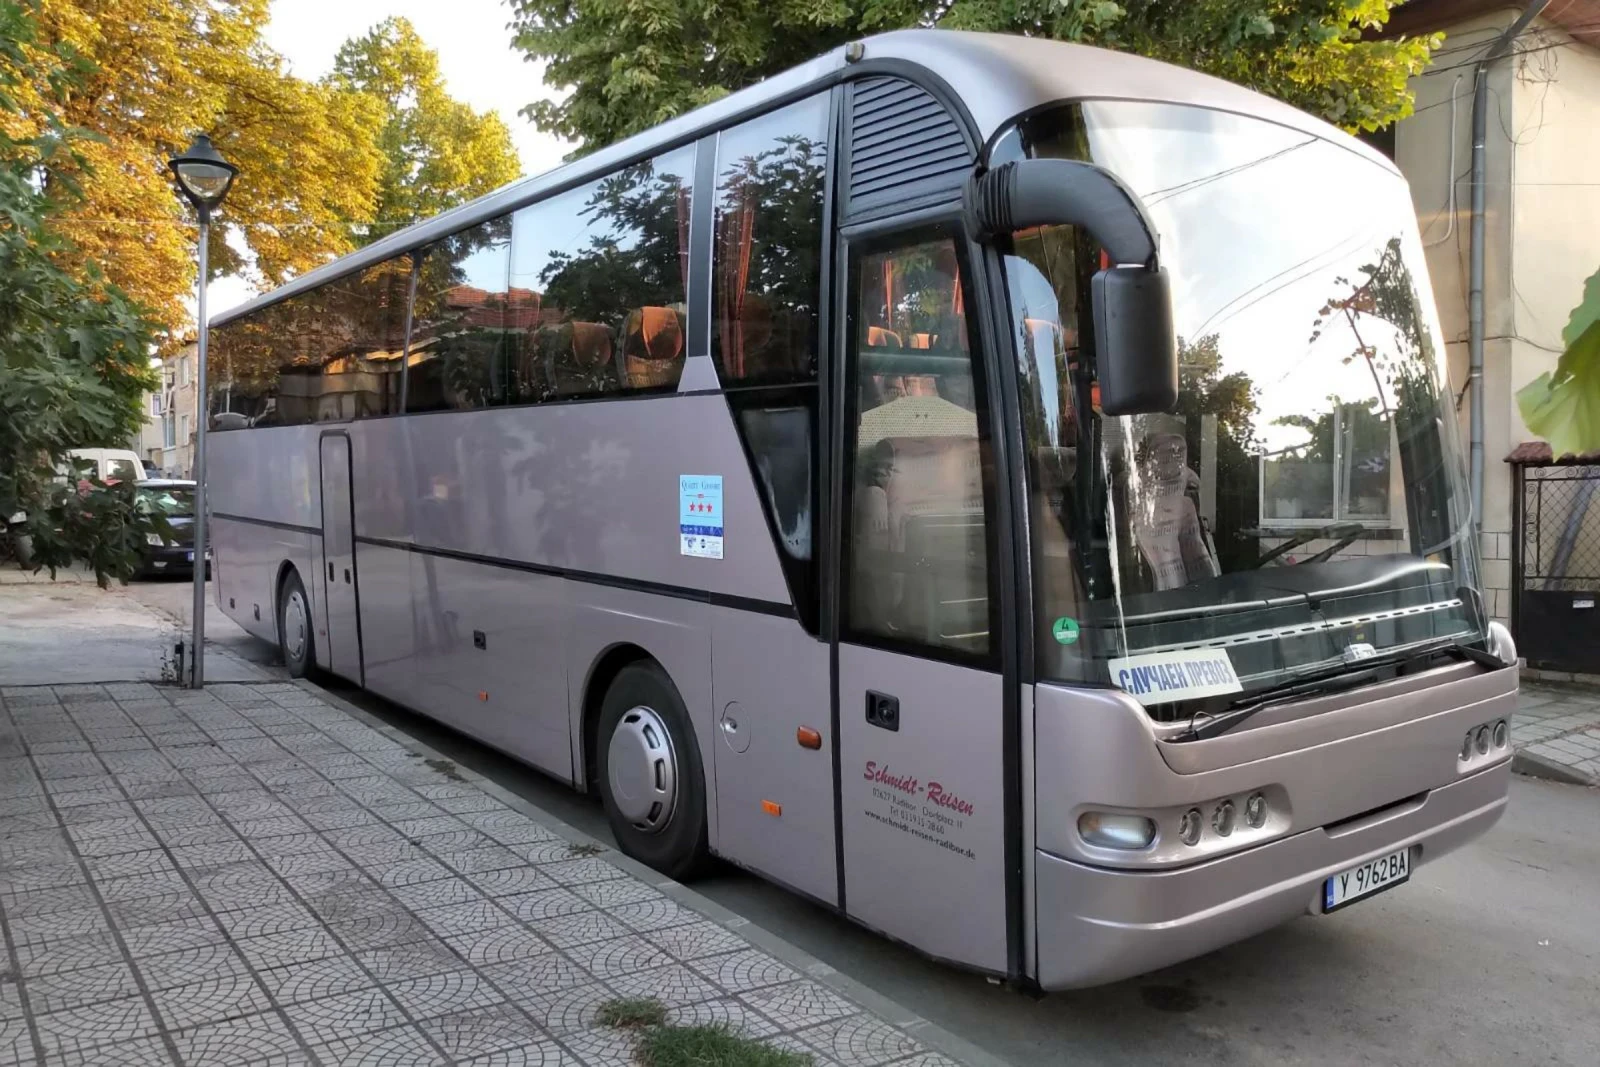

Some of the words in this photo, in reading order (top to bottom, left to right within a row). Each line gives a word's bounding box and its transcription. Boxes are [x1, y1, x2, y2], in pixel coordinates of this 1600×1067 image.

[1118, 660, 1188, 695] СЛУЧАЕН
[1183, 658, 1234, 688] ПРЕВОЗ
[864, 810, 977, 861] www.schmidt-reisen-radibor.de
